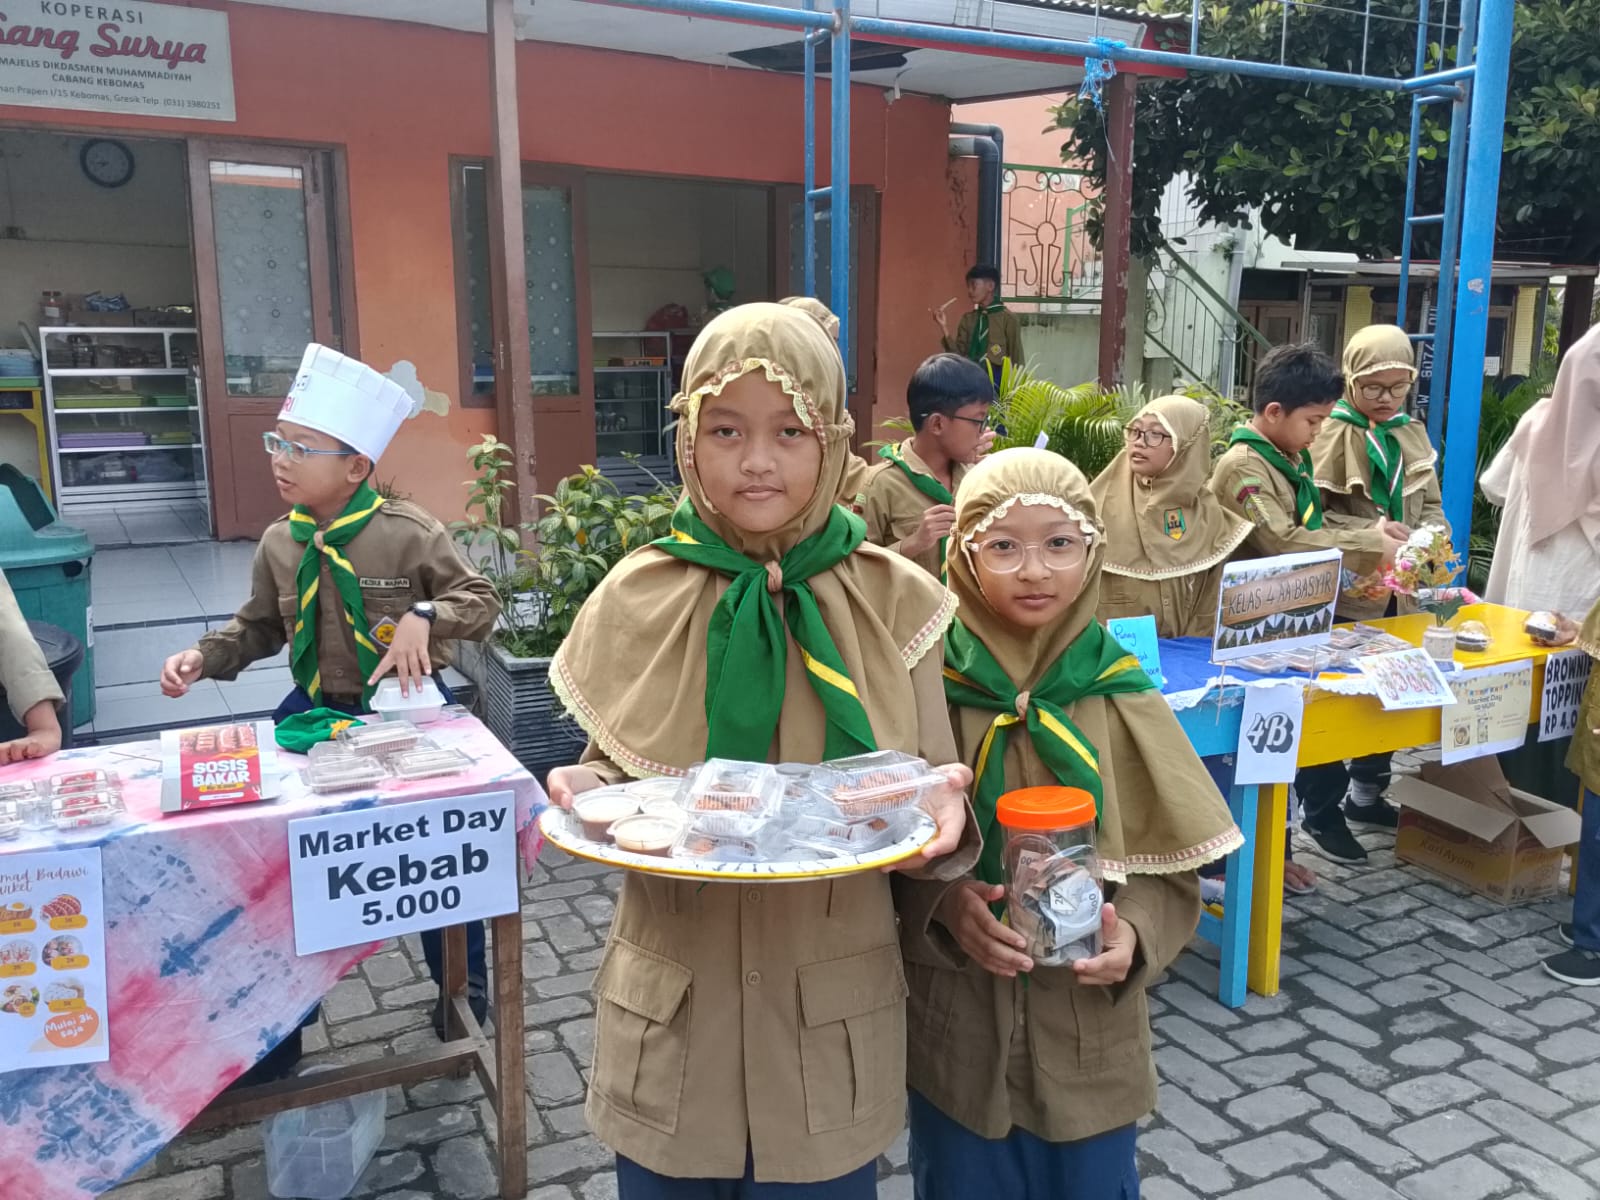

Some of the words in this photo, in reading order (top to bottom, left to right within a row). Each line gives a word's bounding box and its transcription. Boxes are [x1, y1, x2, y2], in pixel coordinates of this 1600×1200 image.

[40, 0, 144, 24] KOPERASI
[0, 12, 80, 60] ang
[89, 22, 208, 70] Surya
[0, 57, 41, 69] MAJELIS
[43, 61, 104, 74] DIKDASMEN
[106, 66, 192, 83] MUHAMMADIYAH
[52, 73, 95, 86] CABANG
[97, 78, 145, 89] KEBOMAS
[17, 85, 49, 98] Prapen
[1228, 588, 1262, 616] KELAS
[1266, 585, 1275, 605] 4
[1279, 583, 1292, 602] AA
[1294, 571, 1333, 601] BASYIR
[1490, 693, 1503, 703] Day
[1246, 711, 1295, 754] 4B
[1545, 713, 1558, 735] RP
[193, 759, 249, 774] SOSIS
[192, 770, 251, 788] BAKAR
[299, 814, 430, 859] Market
[443, 807, 507, 834] Day
[36, 866, 89, 881] Badawi
[327, 842, 489, 900] Kebab
[362, 885, 461, 926] 5.000
[45, 1017, 76, 1034] Mulai
[79, 1013, 94, 1024] 3k
[60, 1025, 84, 1038] saja
